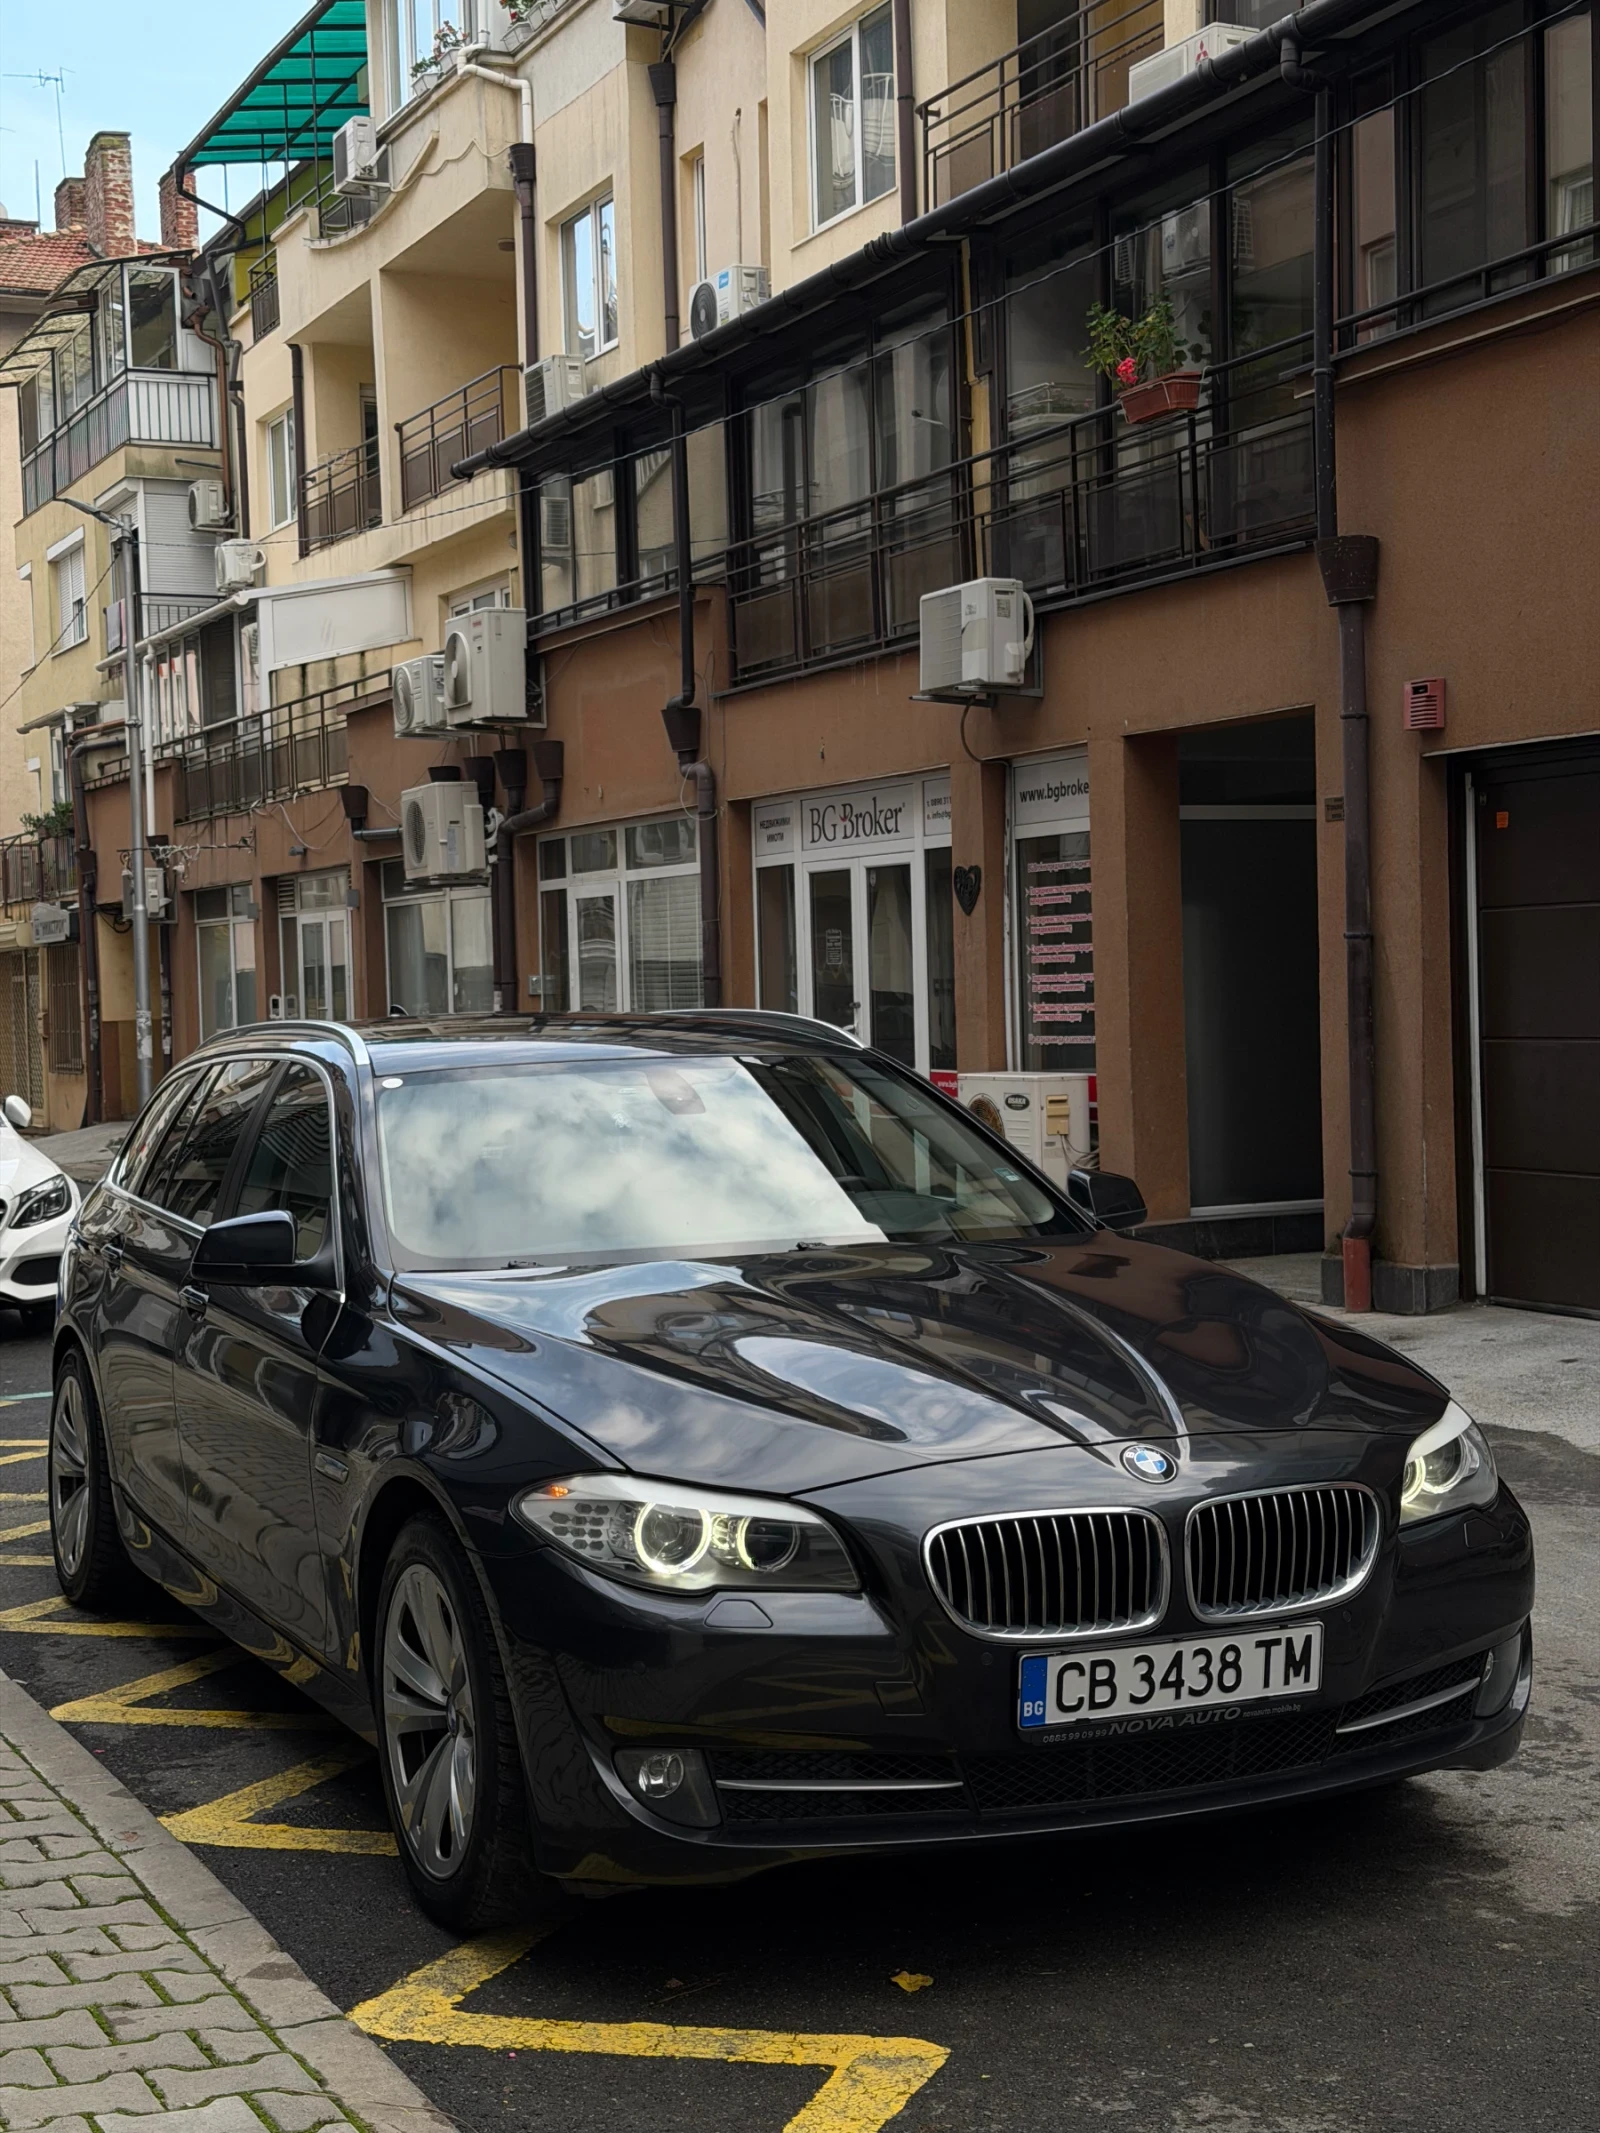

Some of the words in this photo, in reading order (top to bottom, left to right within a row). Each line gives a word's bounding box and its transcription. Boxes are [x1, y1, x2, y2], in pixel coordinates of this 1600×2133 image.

[810, 804, 838, 844] BG
[1056, 1658, 1118, 1713] CB
[1129, 1643, 1242, 1705] 3438
[1255, 1633, 1313, 1689] TM
[1023, 1700, 1044, 1717] BG
[1108, 1716, 1174, 1735] NOVA
[1178, 1707, 1241, 1726] AUTO
